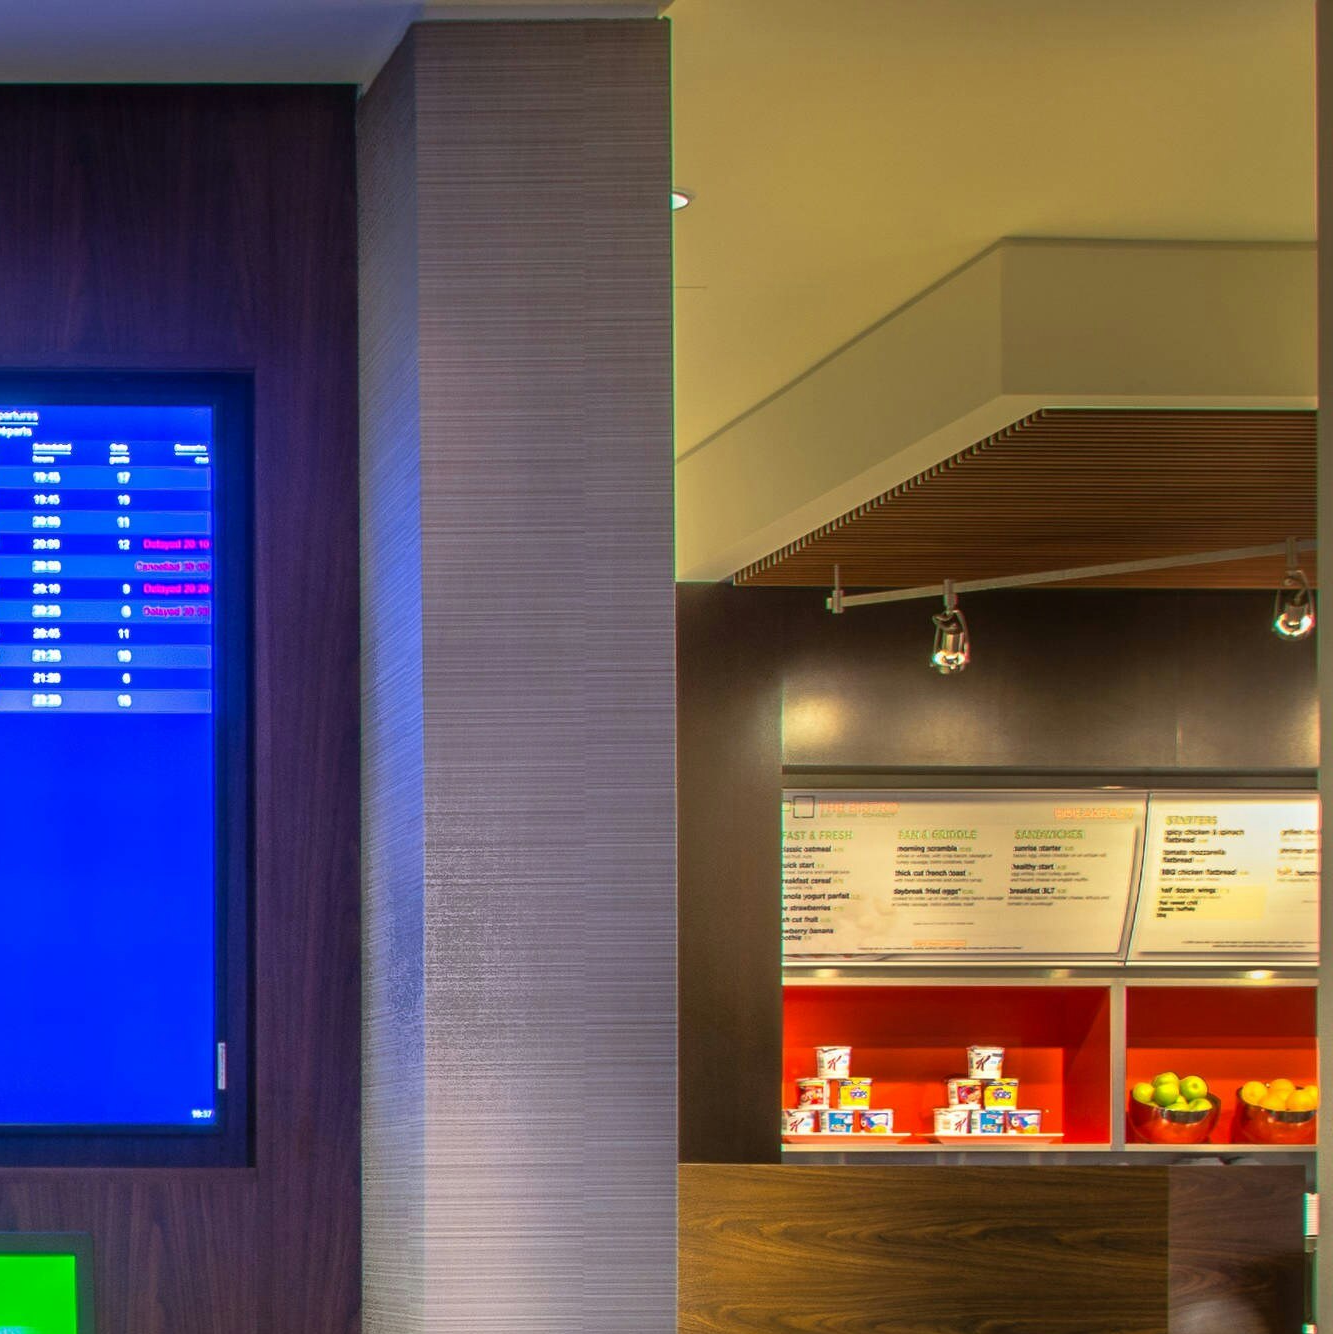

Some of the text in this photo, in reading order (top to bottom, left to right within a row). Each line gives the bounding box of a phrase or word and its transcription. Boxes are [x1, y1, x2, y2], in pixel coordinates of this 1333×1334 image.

[819, 830, 854, 840] FRESH
[897, 845, 926, 853] morning
[1011, 863, 1036, 872] healthy
[1178, 868, 1204, 876] chicken
[1205, 868, 1237, 876] flatbread
[1009, 887, 1040, 895] breakfast
[803, 892, 850, 901] yogurt parfait
